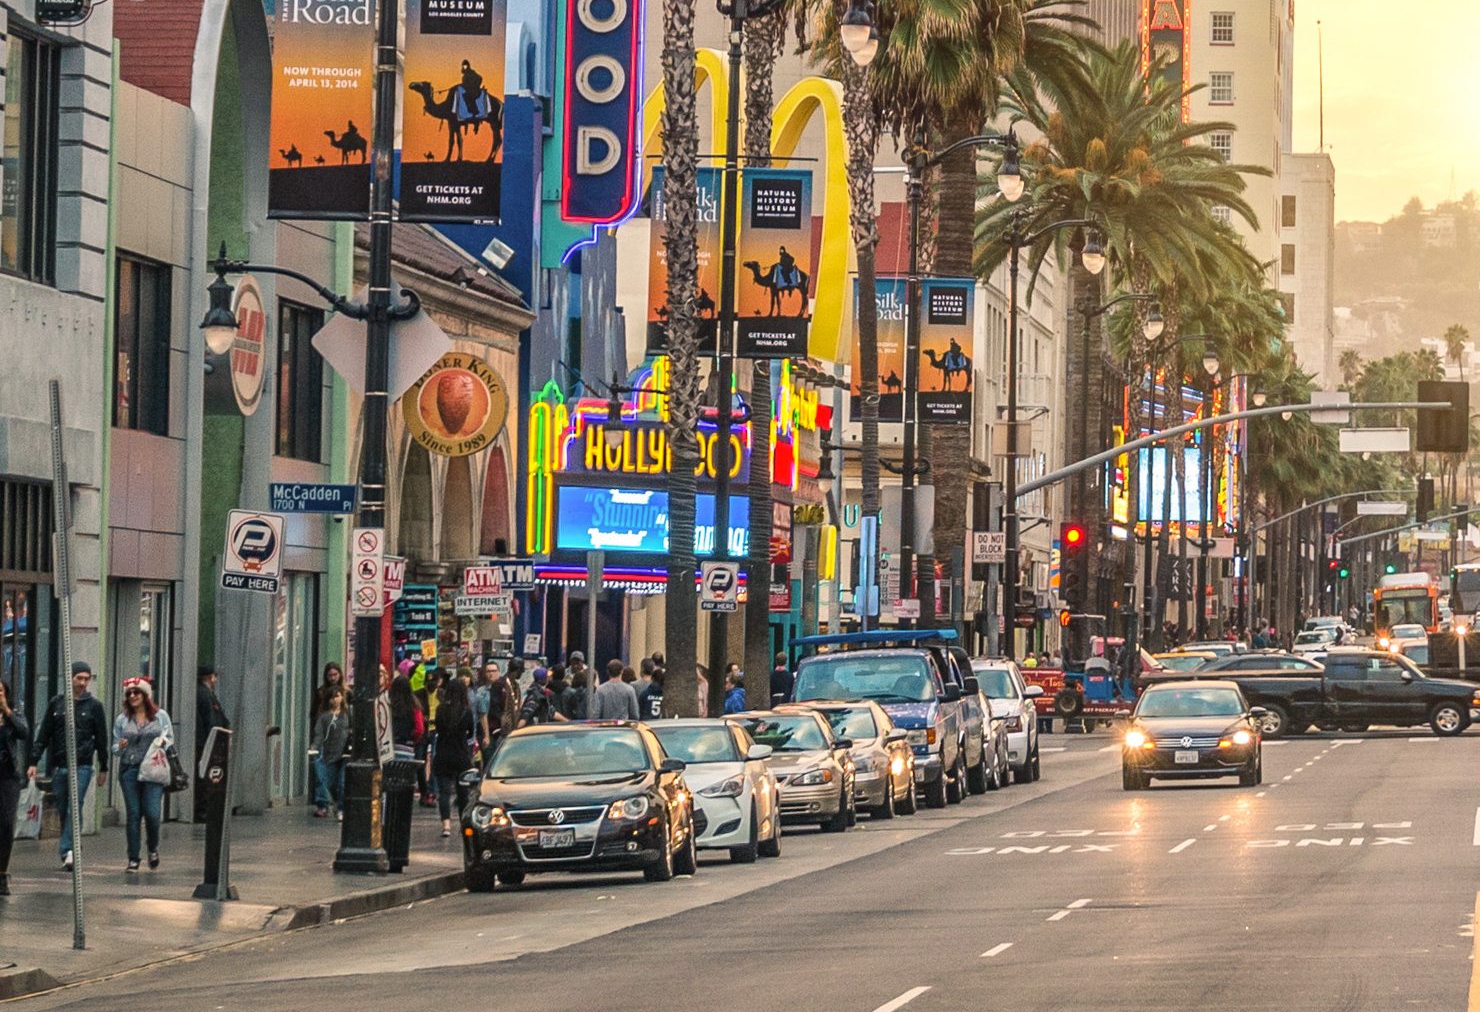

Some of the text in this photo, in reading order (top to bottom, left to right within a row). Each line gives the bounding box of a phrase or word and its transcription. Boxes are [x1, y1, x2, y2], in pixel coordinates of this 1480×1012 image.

[428, 0, 485, 10] MUSEUM
[283, 66, 362, 77] NOW THROUGH
[289, 78, 358, 89] APRIL 13, 2014
[415, 185, 484, 194] GET TICKETS AT
[757, 189, 796, 197] NATURAL
[426, 195, 472, 205] NHM.ORG
[876, 303, 903, 320] oad
[468, 358, 500, 395] KING
[419, 430, 486, 454] Since 1989
[273, 485, 340, 501] McCadden
[273, 499, 294, 510] 1700
[298, 500, 305, 510] N
[978, 535, 1004, 543] DO NOT
[980, 544, 1002, 554] BLOCK
[225, 575, 275, 590] PAY HERE
[467, 569, 499, 586] ATM
[457, 596, 508, 607] INTERNET
[703, 602, 736, 611] PAY HERE
[651, 700, 661, 716] 5
